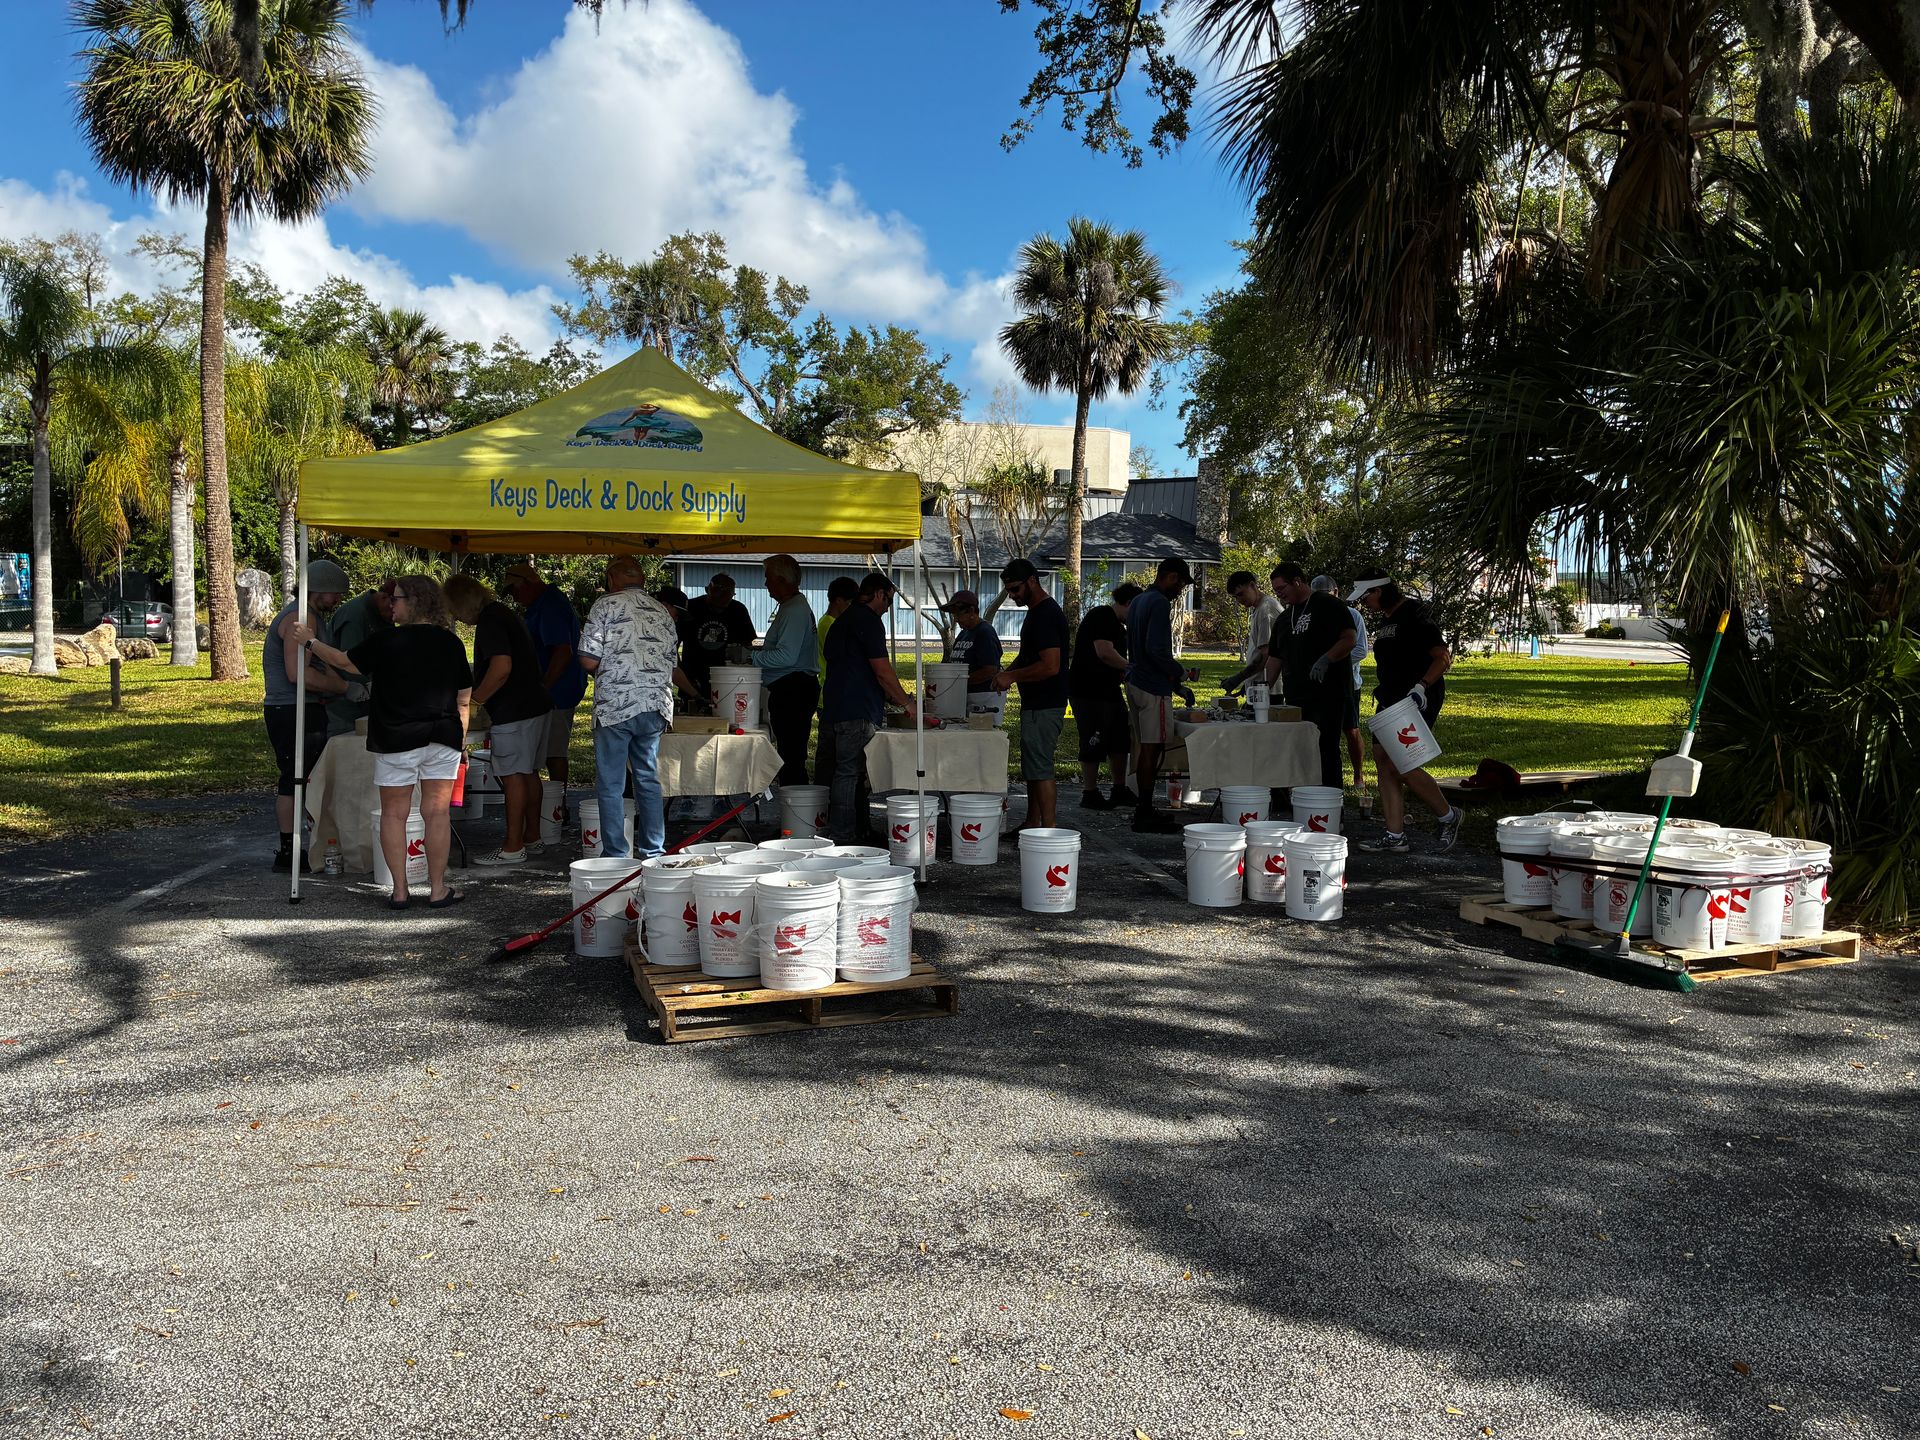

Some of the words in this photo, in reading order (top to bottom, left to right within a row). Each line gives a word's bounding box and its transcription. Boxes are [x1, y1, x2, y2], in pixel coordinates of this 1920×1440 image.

[490, 478, 538, 517] Keys
[545, 477, 593, 509] Deck
[600, 479, 619, 510] &
[626, 480, 674, 511] Dock
[681, 482, 746, 524] Supply
